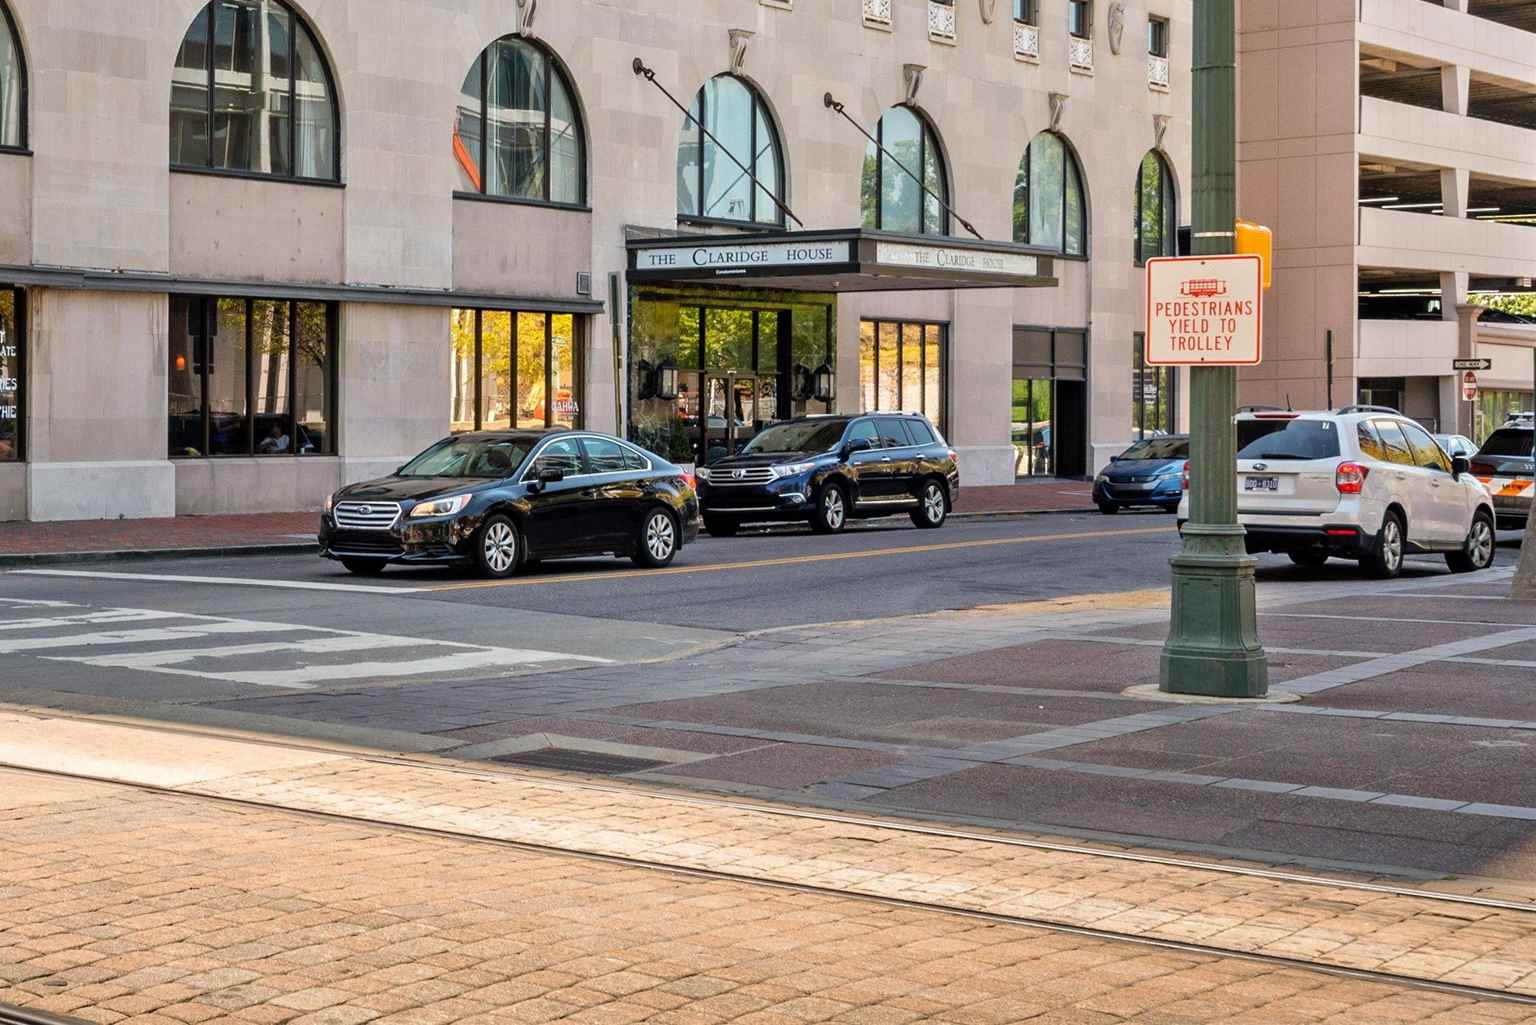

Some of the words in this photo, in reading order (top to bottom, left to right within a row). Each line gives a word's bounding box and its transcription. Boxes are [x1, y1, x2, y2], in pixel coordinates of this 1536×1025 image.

[649, 254, 676, 266] THE
[787, 248, 833, 261] HOUSE
[915, 251, 929, 264] THE
[1155, 300, 1253, 317] PEDESTRIANS
[1169, 319, 1209, 334] YIELD
[1220, 318, 1236, 333] TO
[1170, 336, 1232, 351] TROLLEY
